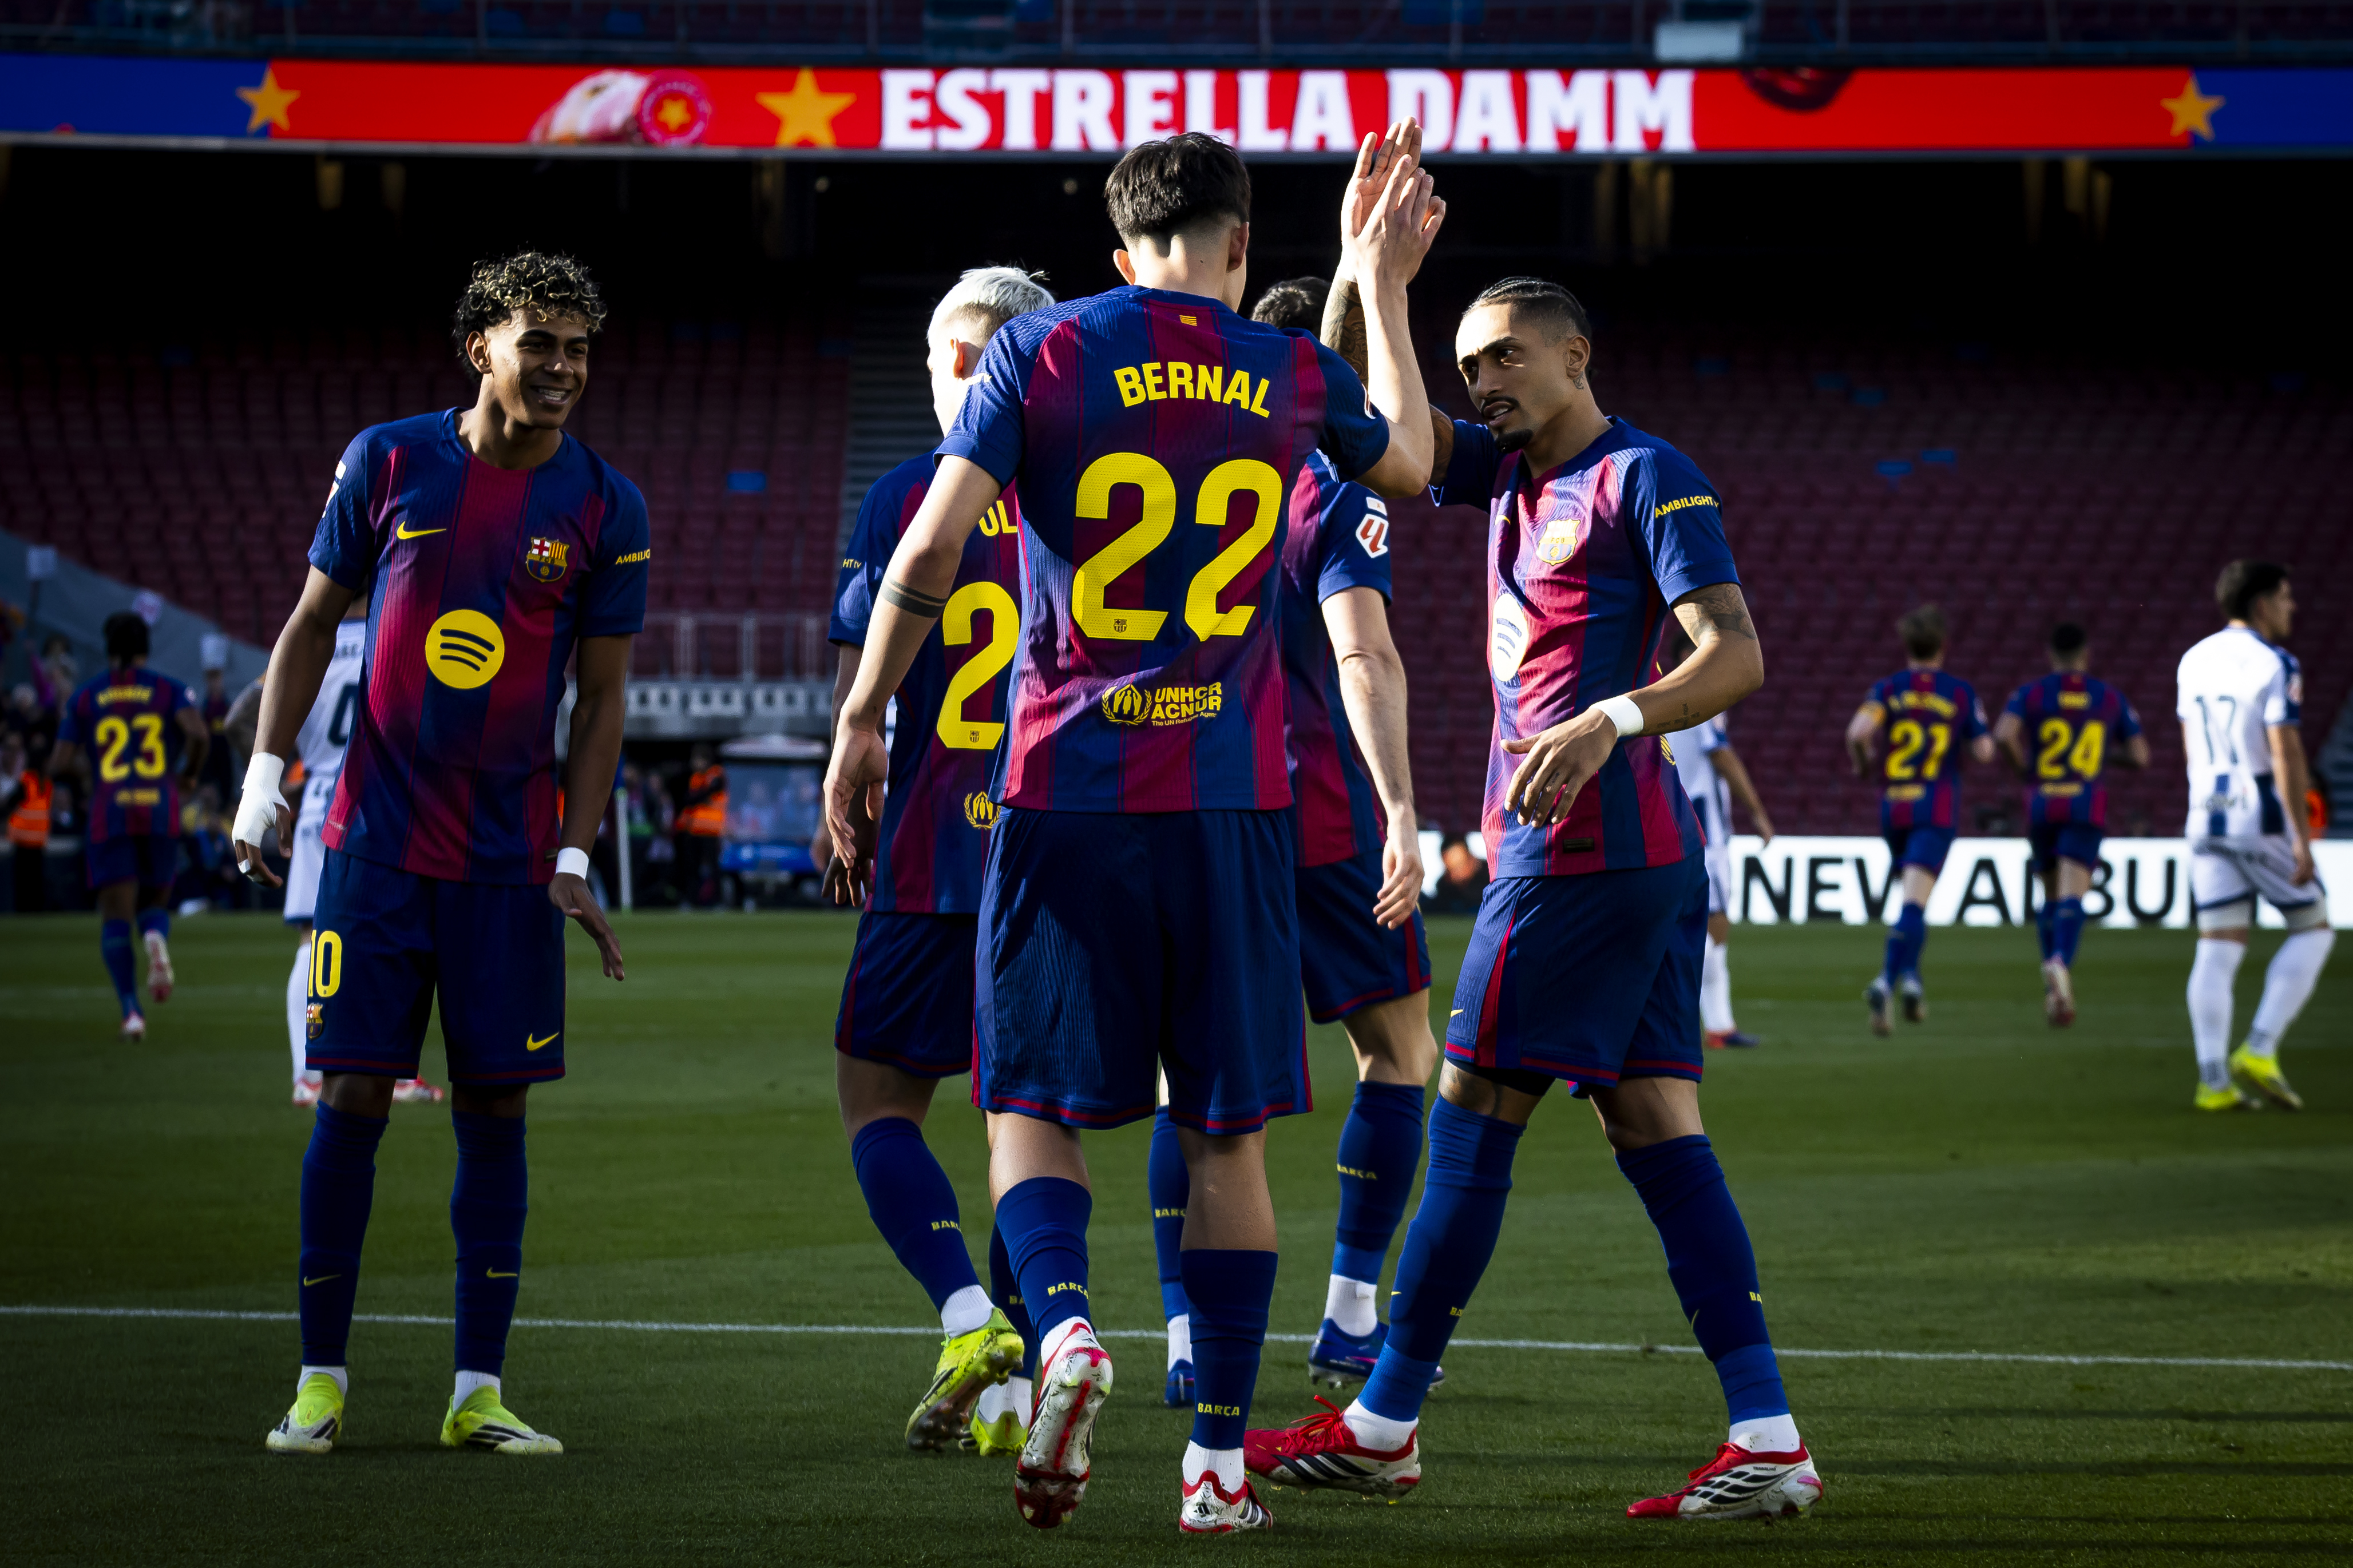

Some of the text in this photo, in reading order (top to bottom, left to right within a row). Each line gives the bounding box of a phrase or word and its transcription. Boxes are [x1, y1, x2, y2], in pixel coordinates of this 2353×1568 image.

[880, 68, 1695, 152] ESTRELLA DAMM
[1113, 361, 1271, 418] BERNAL
[1655, 495, 1713, 518] AMBILIGHT
[1071, 452, 1283, 642] 22
[1151, 695, 1222, 720] ACNUR
[1155, 681, 1222, 703] UNHCR
[96, 713, 167, 783] 23
[2038, 716, 2106, 781] 24
[2194, 694, 2239, 765] 17
[308, 930, 342, 998] 10
